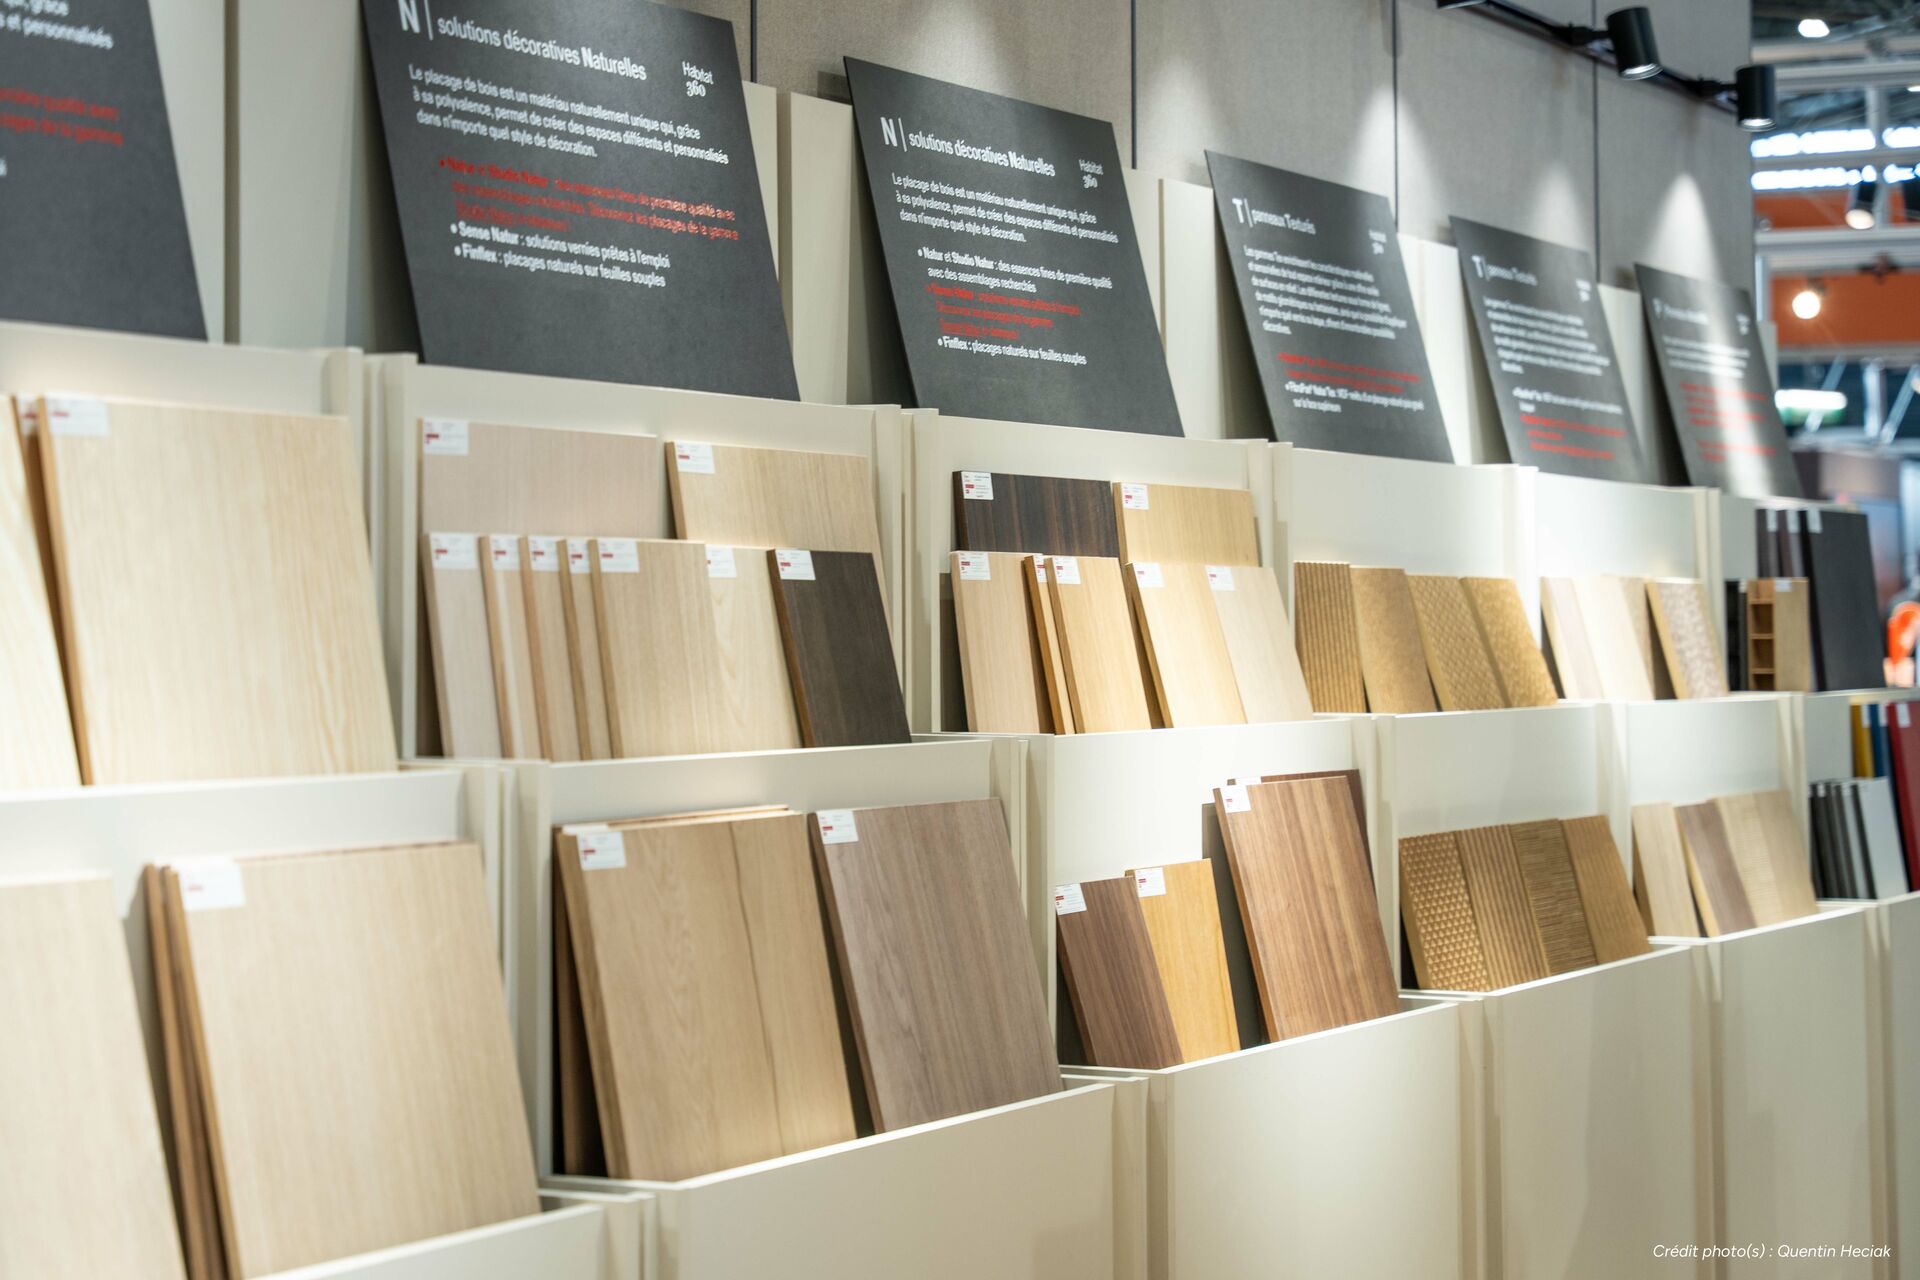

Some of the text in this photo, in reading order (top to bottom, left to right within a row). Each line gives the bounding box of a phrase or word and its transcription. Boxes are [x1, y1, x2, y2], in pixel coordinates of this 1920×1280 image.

[398, 0, 647, 80] N solutions décoratives Naturelles
[682, 61, 714, 85] Habitat
[686, 79, 706, 97] 360
[408, 64, 423, 80] Le
[423, 69, 463, 92] placage
[463, 77, 477, 92] de
[476, 79, 499, 97] bois
[498, 87, 515, 100] est
[514, 90, 528, 103] un
[569, 101, 630, 125] naturellement
[629, 113, 659, 132] unique
[659, 120, 677, 137] qui,
[676, 123, 700, 139] grâce
[412, 85, 420, 101] à
[420, 91, 434, 104] sa
[434, 93, 495, 119] polyvalence,
[494, 106, 529, 124] permet
[528, 110, 542, 126] de
[542, 114, 566, 131] créer
[567, 118, 585, 135] des
[585, 125, 622, 142] espaces
[663, 139, 673, 153] et
[672, 143, 729, 164] personnalisés
[416, 108, 441, 127] dans
[488, 125, 510, 140] quel
[510, 128, 533, 146] style
[533, 132, 546, 147] de
[546, 134, 597, 157] décoration.
[880, 116, 1055, 176] N solutions décoratives Naturelles
[1232, 198, 1244, 223] T
[457, 220, 490, 240] Sense
[490, 226, 519, 244] Natur
[525, 233, 567, 252] solutions
[566, 241, 600, 257] vernies
[600, 244, 629, 262] prêtes
[629, 247, 636, 263] à
[635, 249, 670, 270] l'emploi
[502, 250, 546, 272] placages
[546, 258, 584, 275] naturels
[583, 264, 598, 276] sur
[599, 263, 631, 282] feuilles
[631, 271, 665, 288] souples
